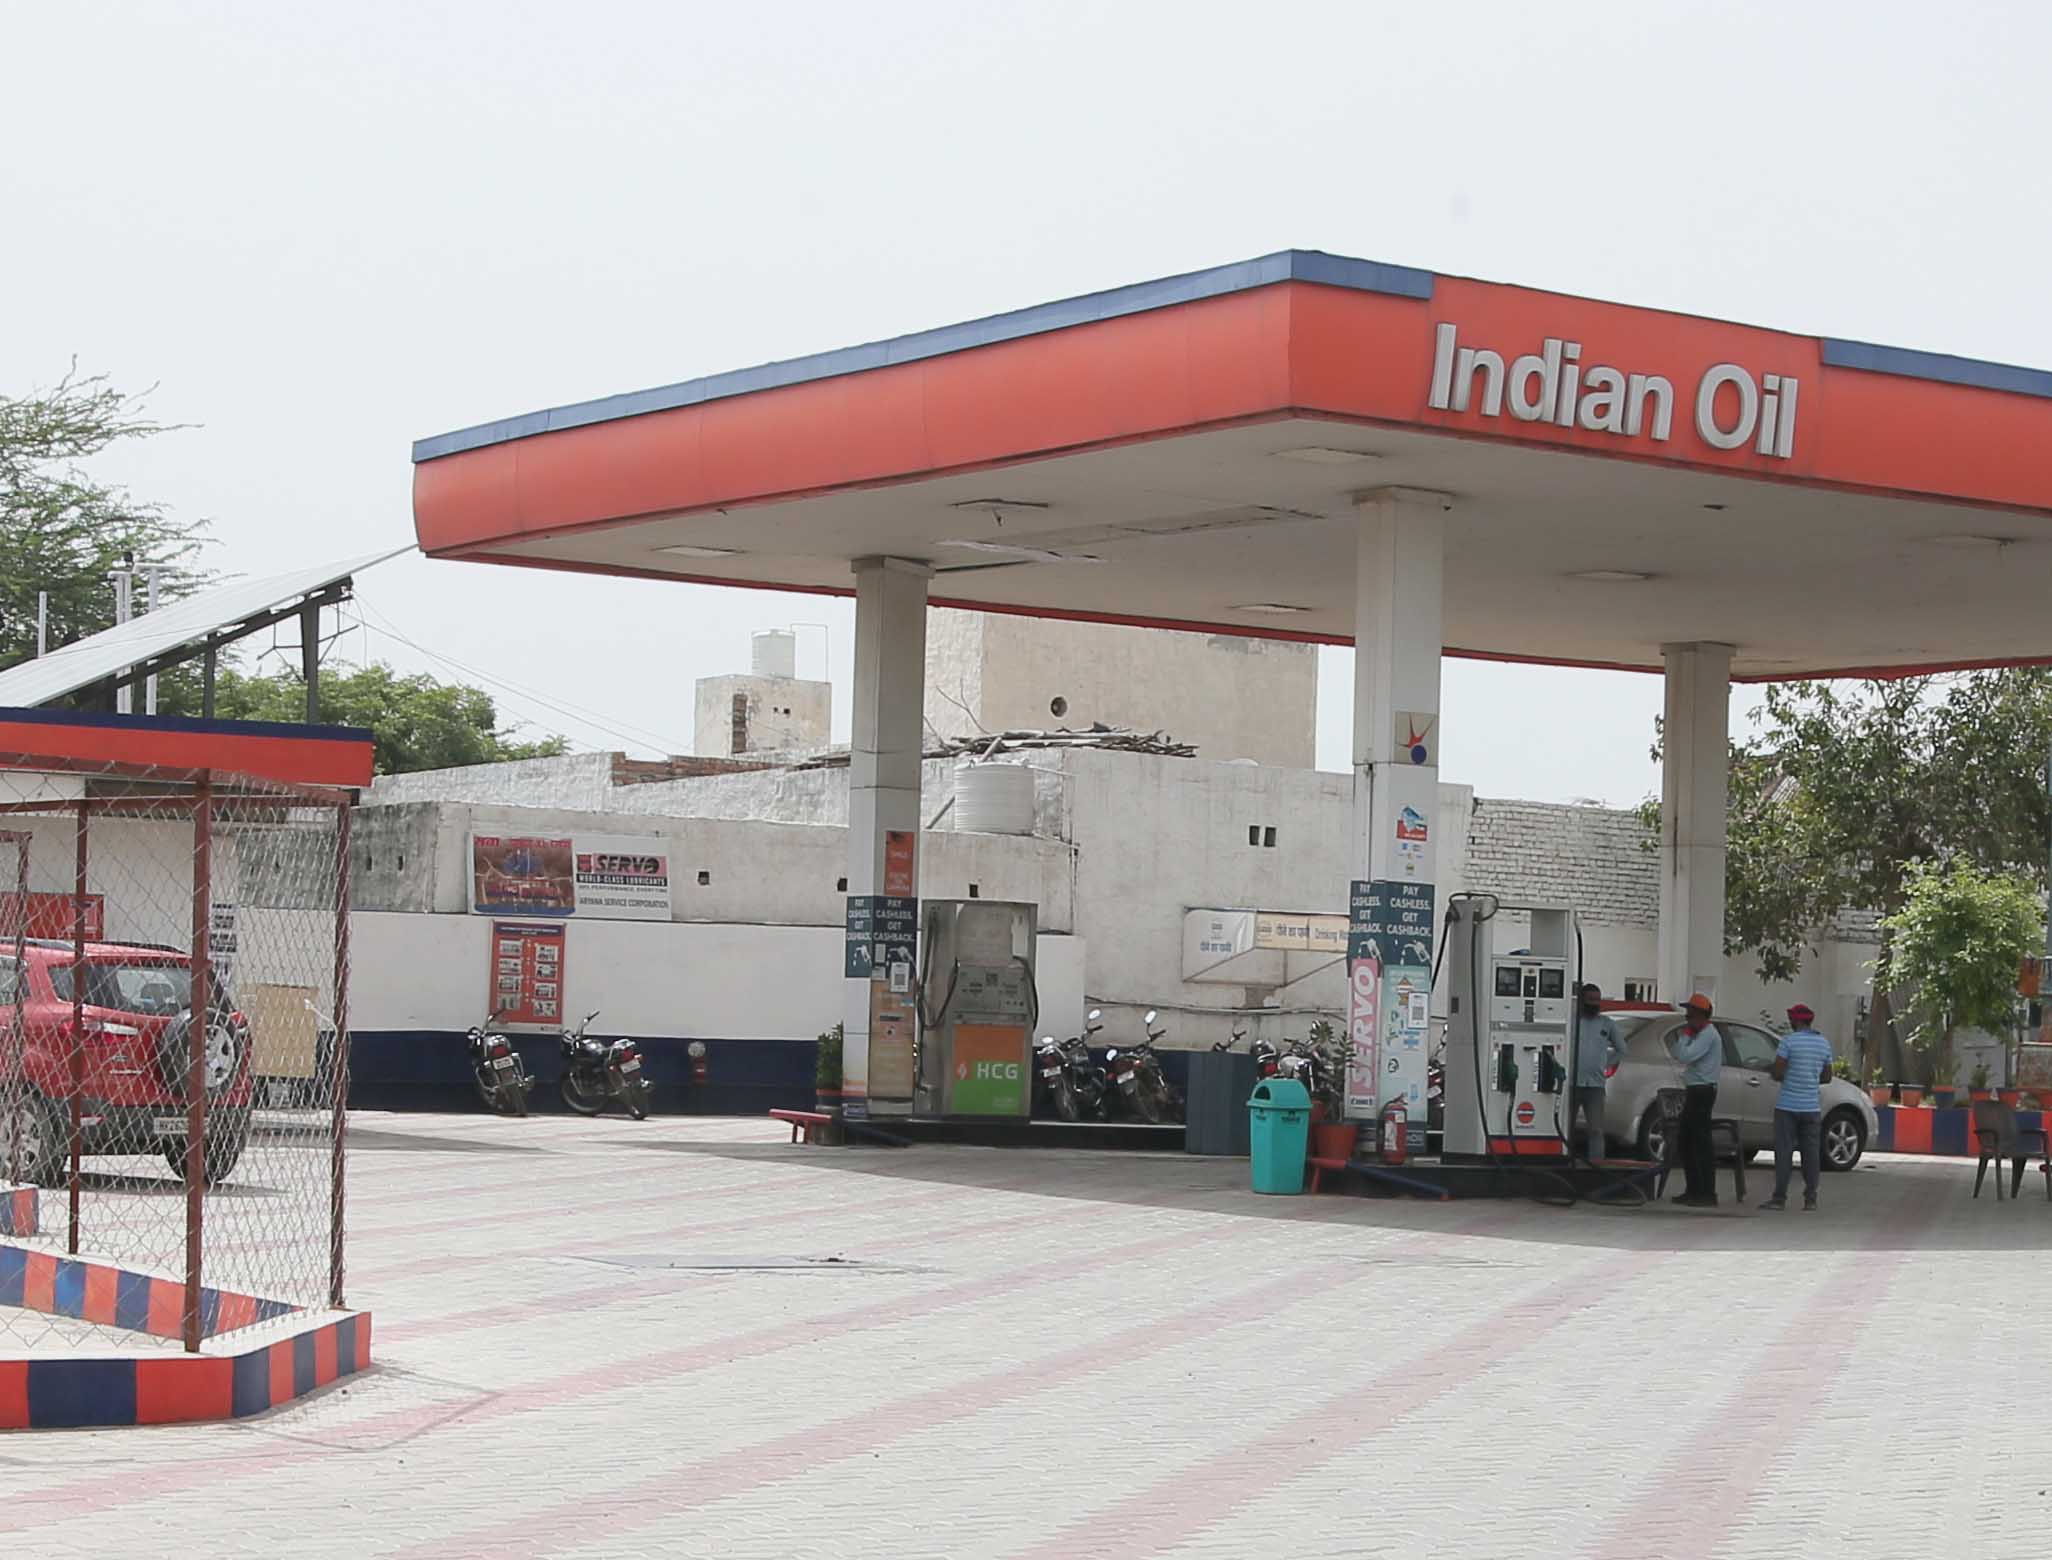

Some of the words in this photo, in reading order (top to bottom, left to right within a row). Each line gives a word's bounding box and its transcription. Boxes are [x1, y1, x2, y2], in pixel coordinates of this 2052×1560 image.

[1428, 323, 1674, 442] Indian
[1696, 363, 1799, 459] Oil
[595, 855, 660, 875] SERVO
[1402, 885, 1420, 896] PAY
[1402, 911, 1419, 922] GET
[1352, 965, 1376, 1089] SERVO
[977, 1063, 1019, 1080] HCG
